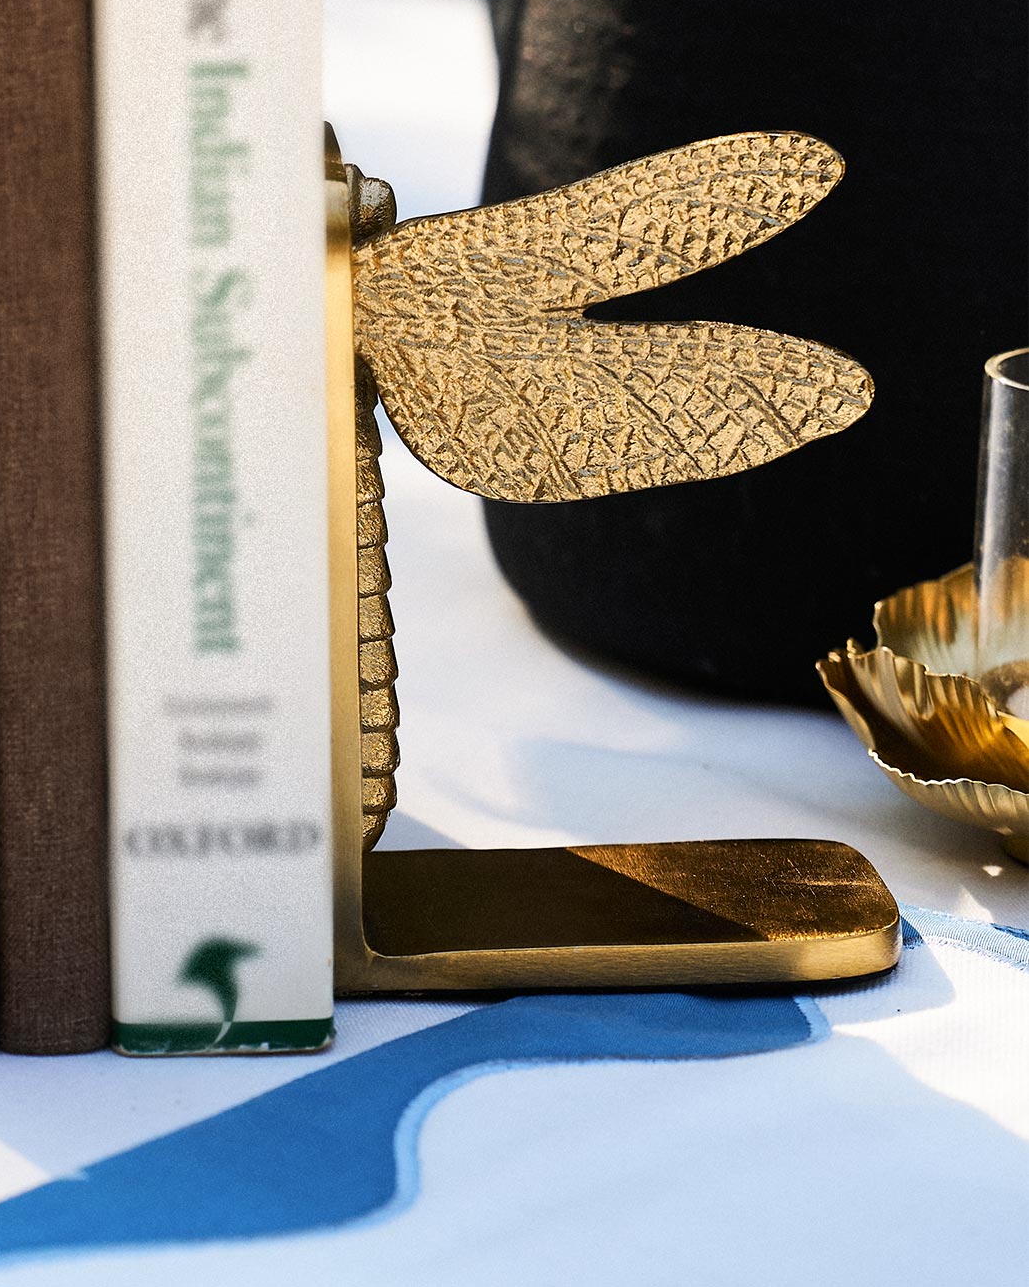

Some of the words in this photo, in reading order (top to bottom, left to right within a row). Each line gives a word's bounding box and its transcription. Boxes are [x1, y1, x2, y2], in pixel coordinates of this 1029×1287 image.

[187, 58, 252, 247] Indian
[187, 266, 253, 656] Subcontinent
[124, 820, 321, 859] OXFORD
